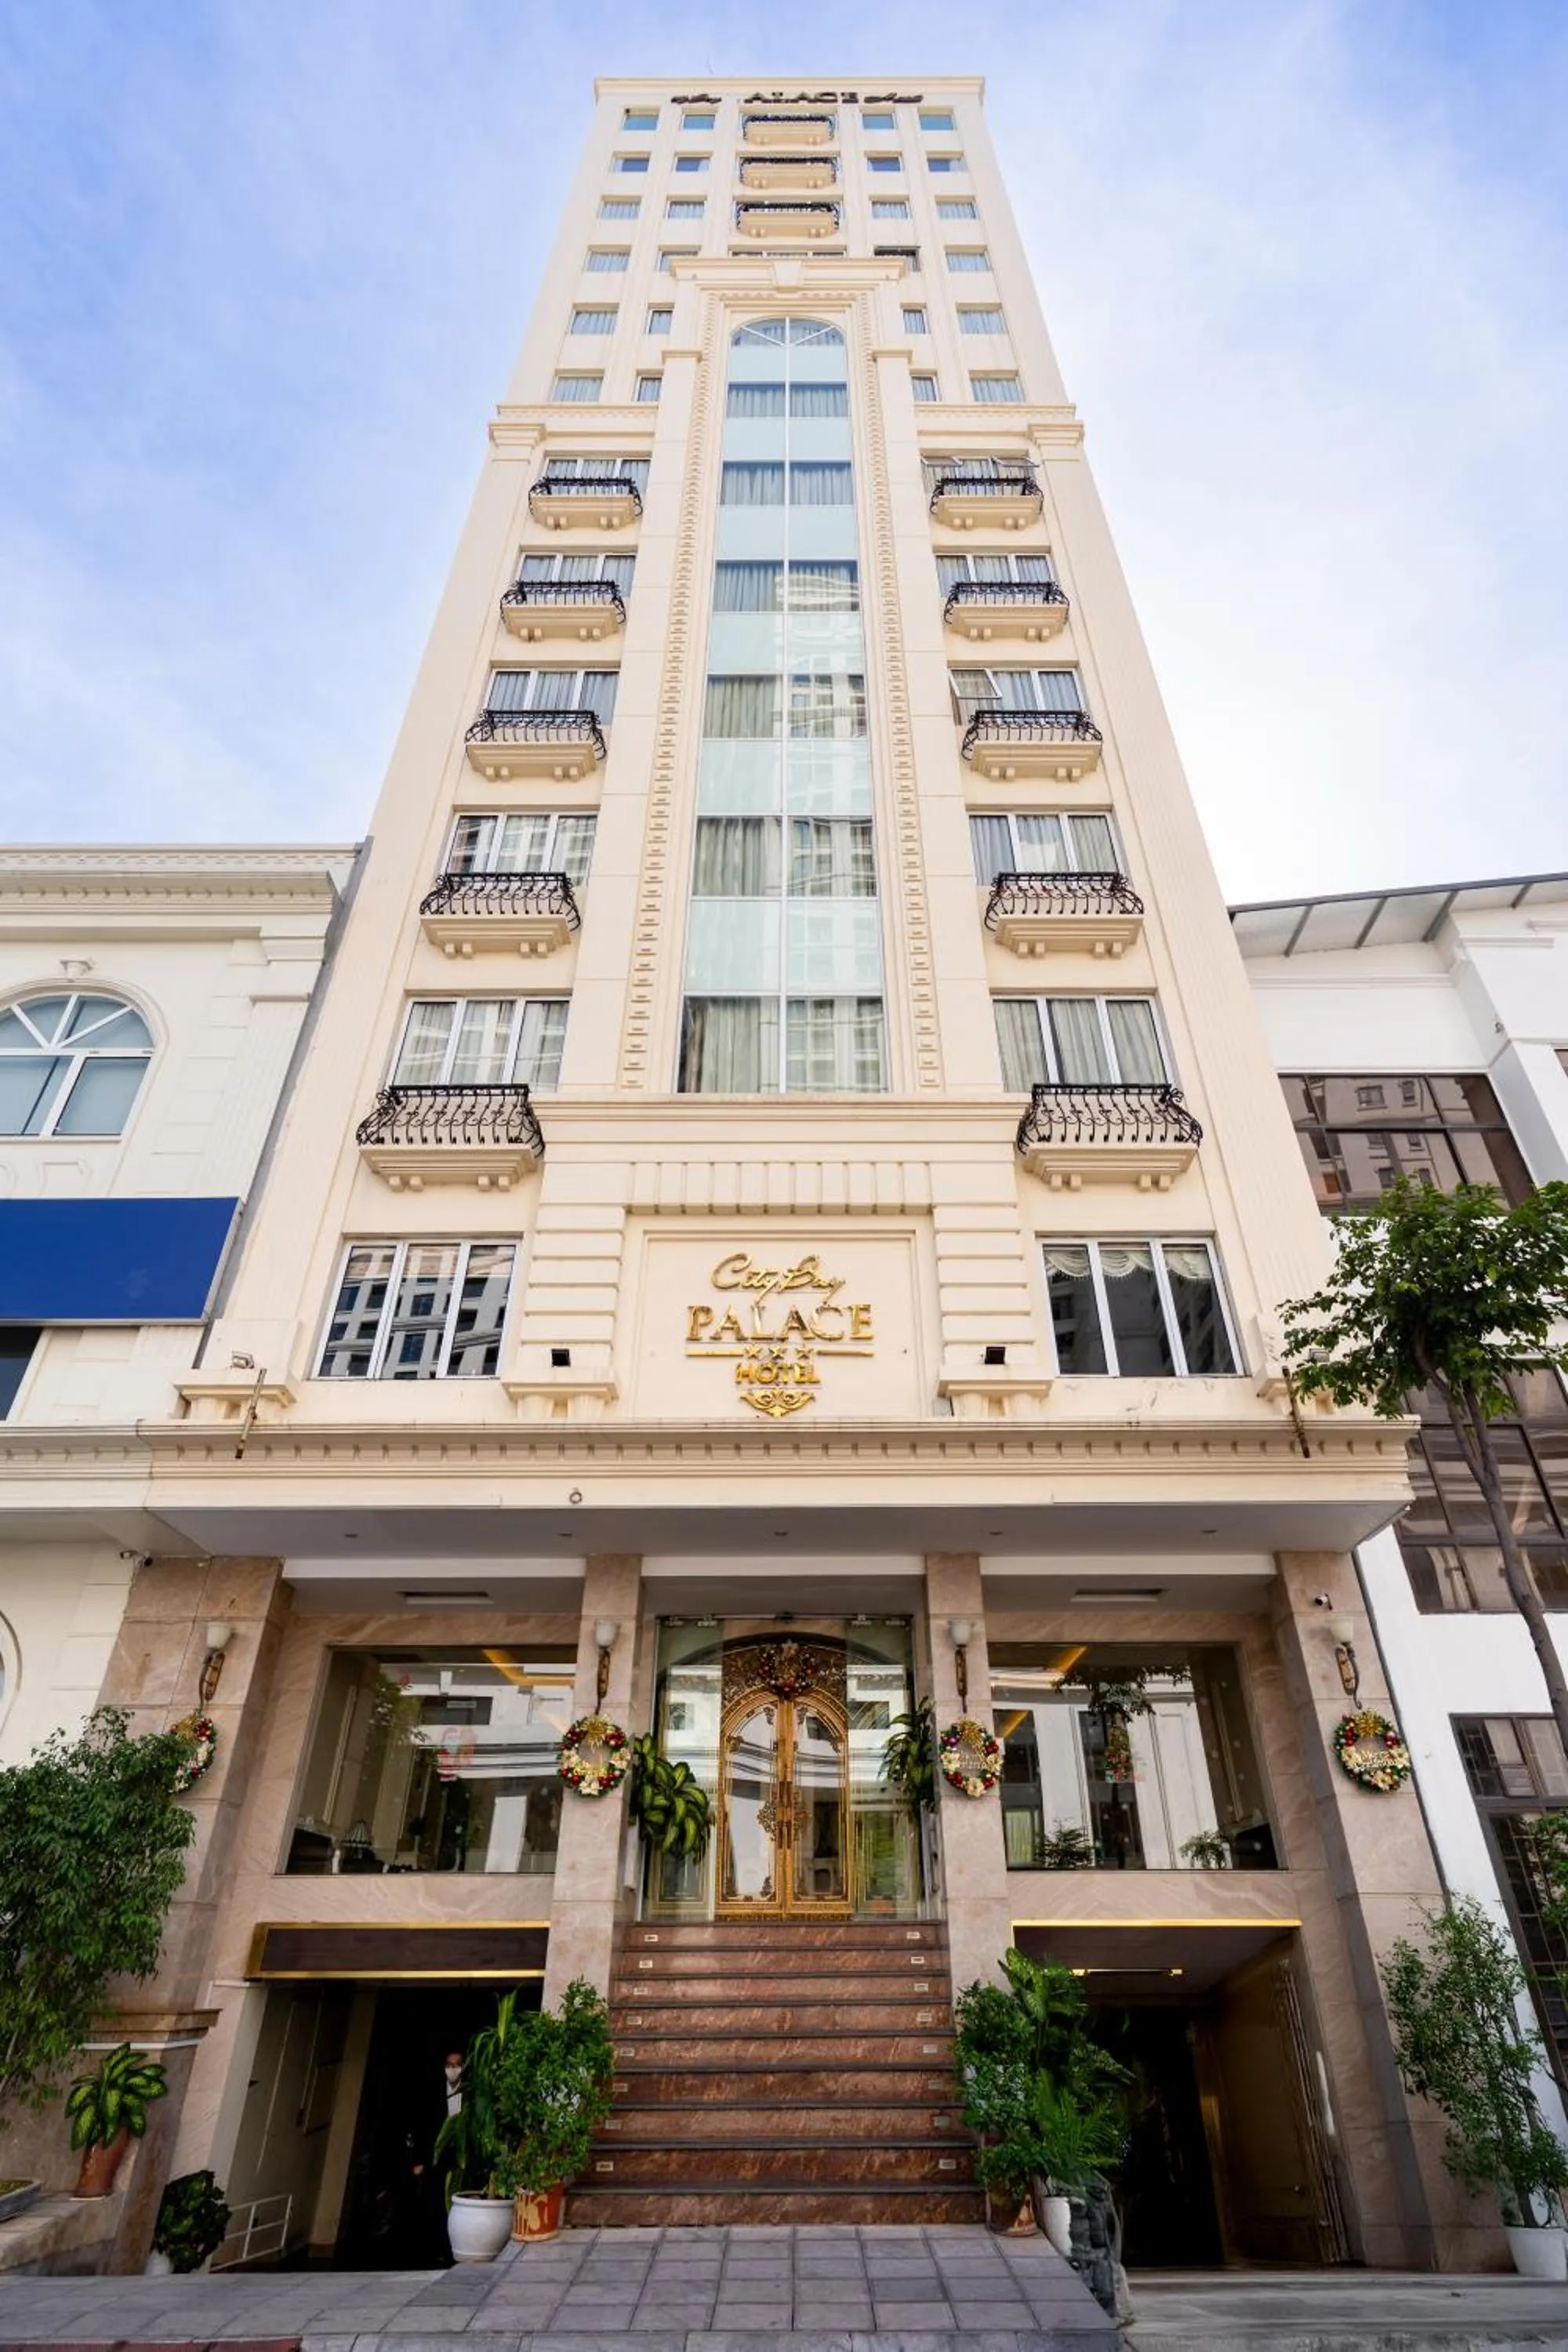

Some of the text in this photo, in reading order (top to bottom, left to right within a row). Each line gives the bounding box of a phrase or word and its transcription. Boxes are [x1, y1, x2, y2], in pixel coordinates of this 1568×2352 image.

[712, 1252, 846, 1305] City Bay
[685, 1303, 874, 1341] PALACE
[735, 1362, 821, 1385] HOTEL
